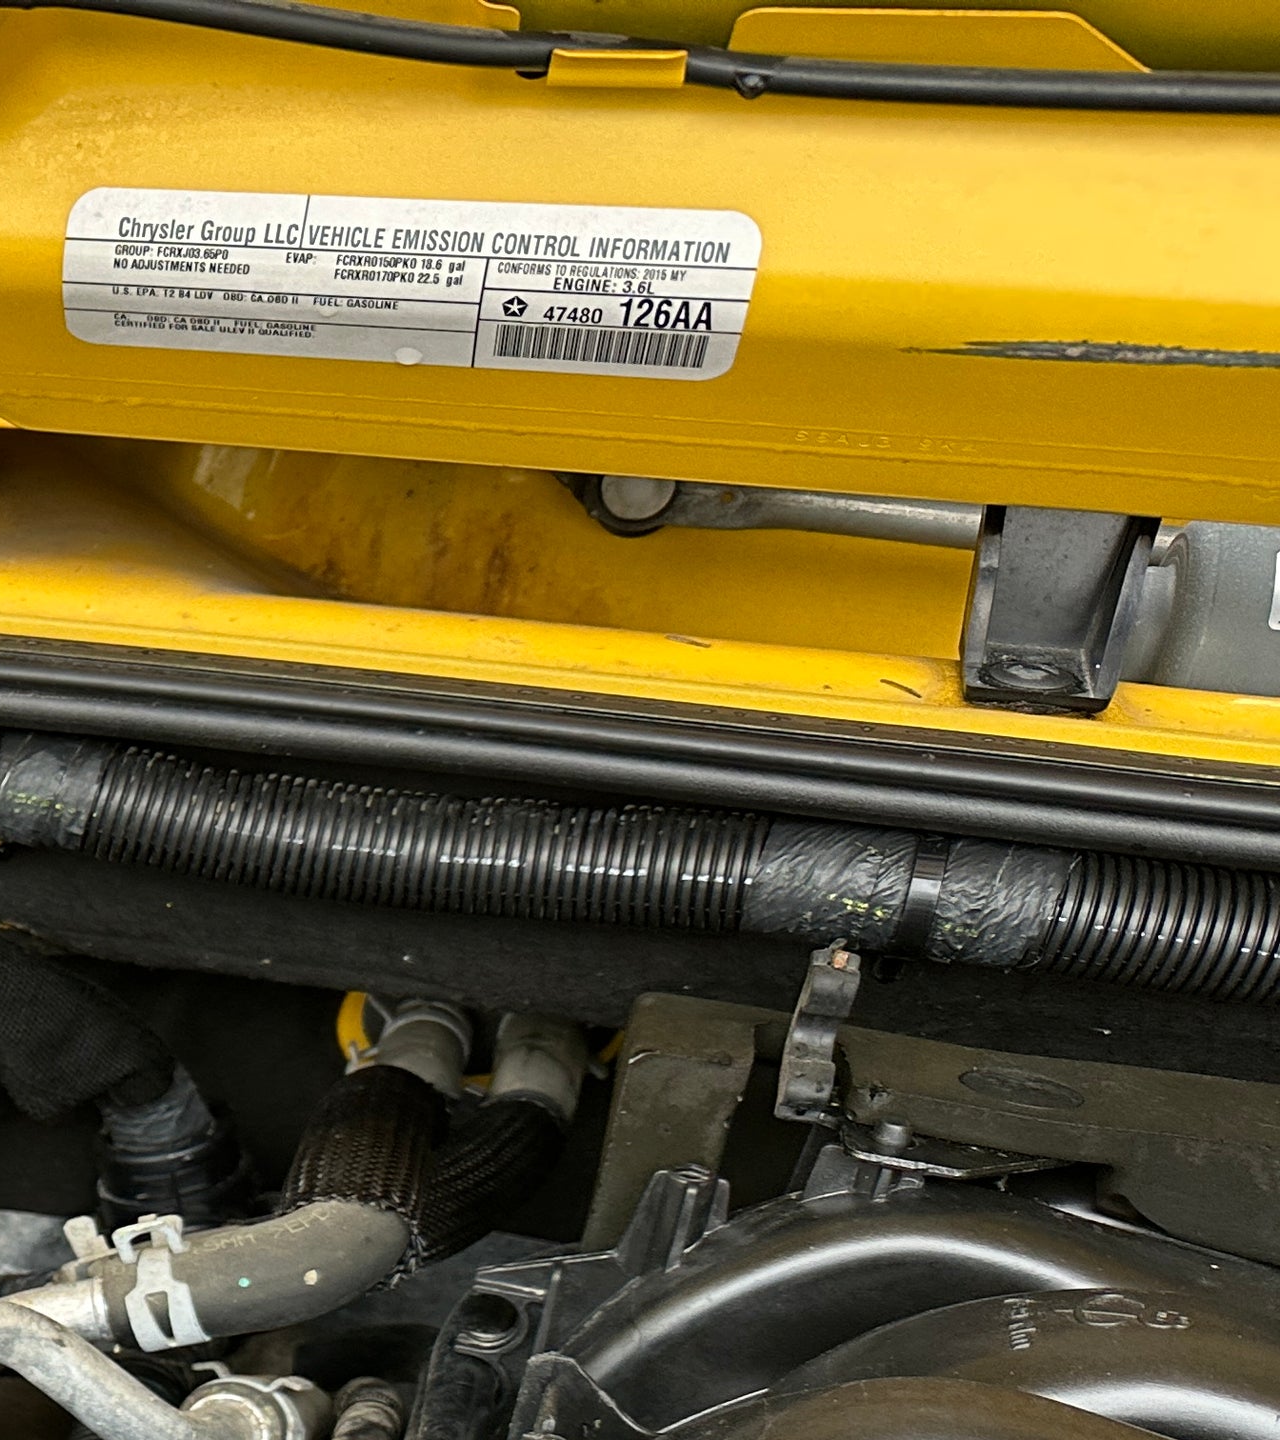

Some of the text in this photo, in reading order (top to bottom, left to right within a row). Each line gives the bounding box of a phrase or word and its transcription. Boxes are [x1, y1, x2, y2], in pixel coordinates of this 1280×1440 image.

[118, 217, 299, 245] Chrysler Group LLC
[115, 245, 154, 257] GROUP:
[309, 225, 731, 263] VEHICLE EMISSION CONTROL INFORMATION
[113, 258, 250, 275] NO ADJUSTMENTS NEEDED
[286, 252, 318, 265] EVAP:
[421, 259, 442, 271] 18.6
[448, 260, 466, 273] gal
[417, 272, 439, 285] 22.5
[446, 275, 463, 287] gal
[498, 262, 687, 281] CONFORMS TO REGULATIONS: 2015 MY
[553, 277, 655, 295] ENGINE: 3.6L
[194, 290, 213, 300] LDV
[313, 296, 343, 307] FUEL:
[346, 299, 399, 310] GASOLINE
[543, 298, 713, 330] 47480 126AA
[114, 320, 165, 330] CERTIFIED
[169, 322, 188, 331] FOR
[191, 324, 215, 332] SALE
[266, 322, 317, 331] GASOLINE
